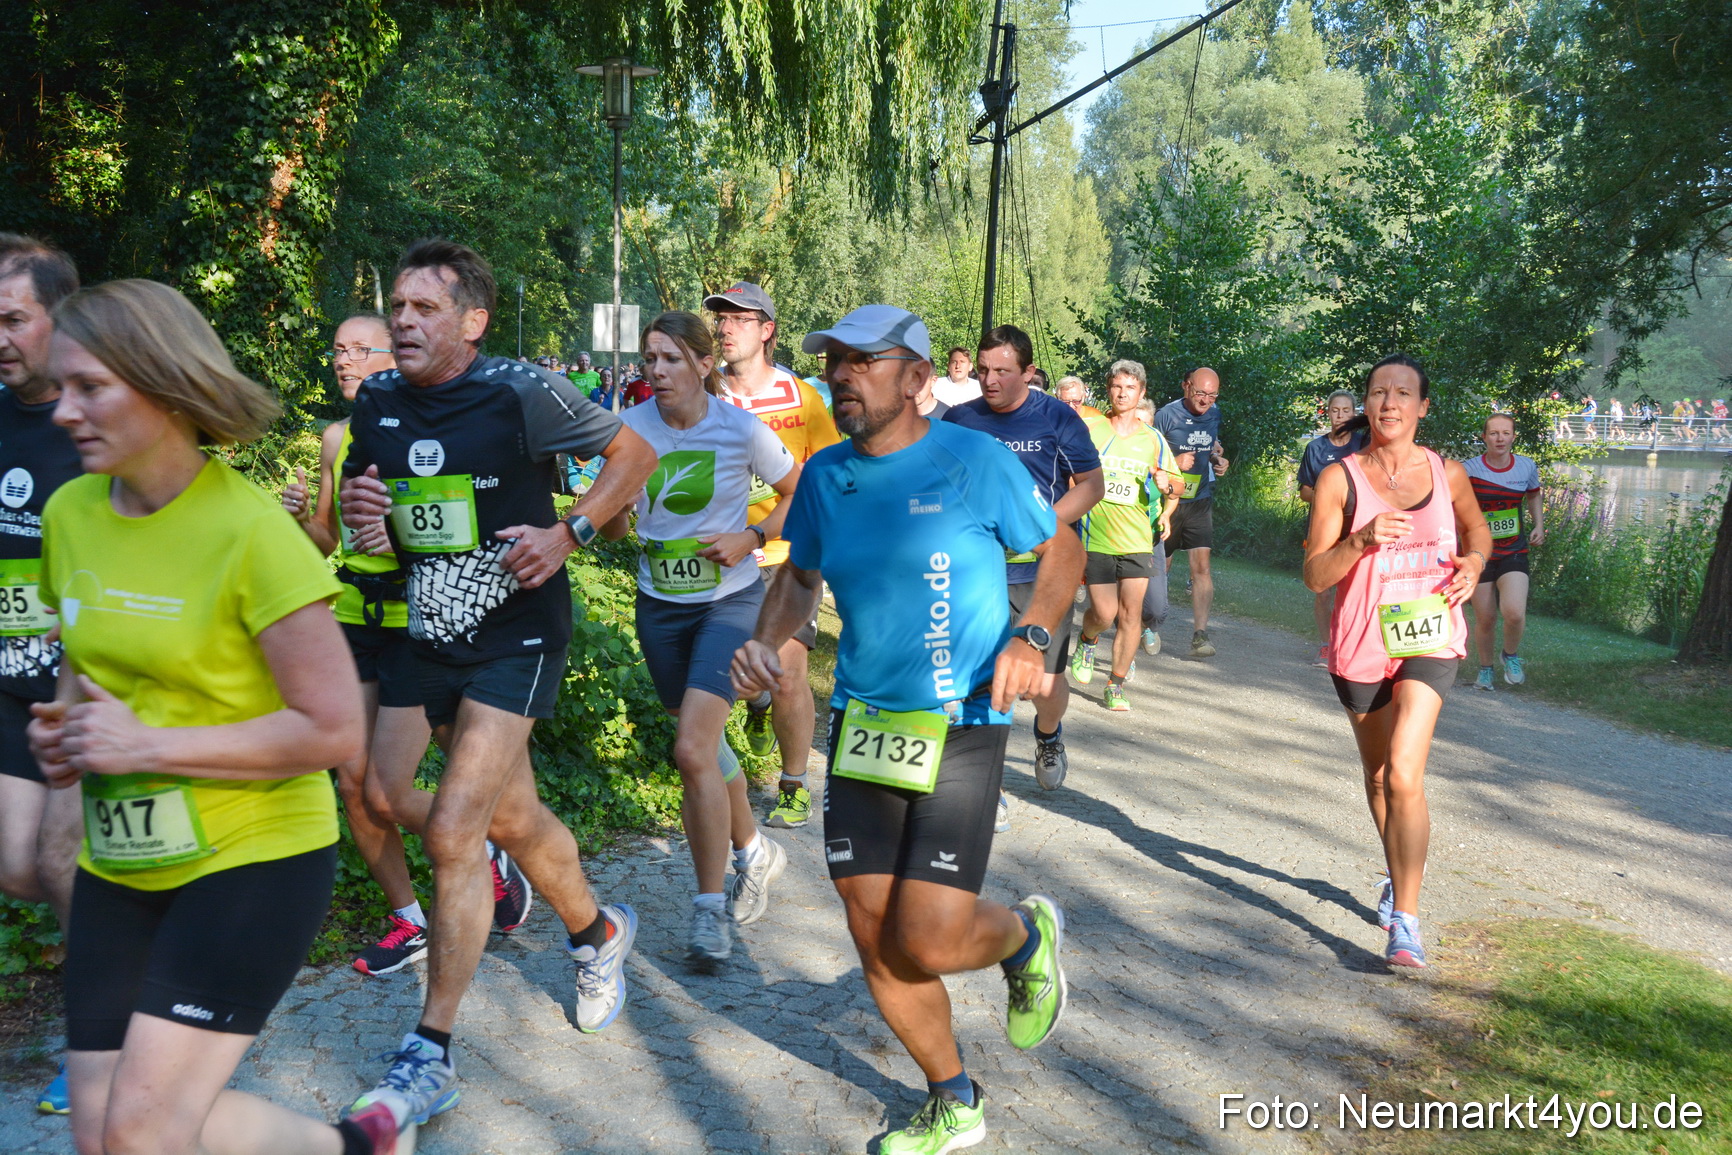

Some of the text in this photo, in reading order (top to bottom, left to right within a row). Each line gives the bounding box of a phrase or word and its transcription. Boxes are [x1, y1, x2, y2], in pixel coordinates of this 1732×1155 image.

[379, 417, 400, 427] JAKO
[471, 476, 499, 489] lein
[1107, 482, 1131, 497] 205
[411, 504, 444, 531] 83
[1487, 518, 1515, 532] 1889
[1386, 541, 1423, 555] Pflegen
[659, 558, 701, 579] 140
[923, 551, 957, 700] meiko.de
[1390, 614, 1442, 641] 1447
[849, 729, 927, 767] 2132
[96, 798, 155, 838] 917
[172, 1003, 215, 1021] adidas
